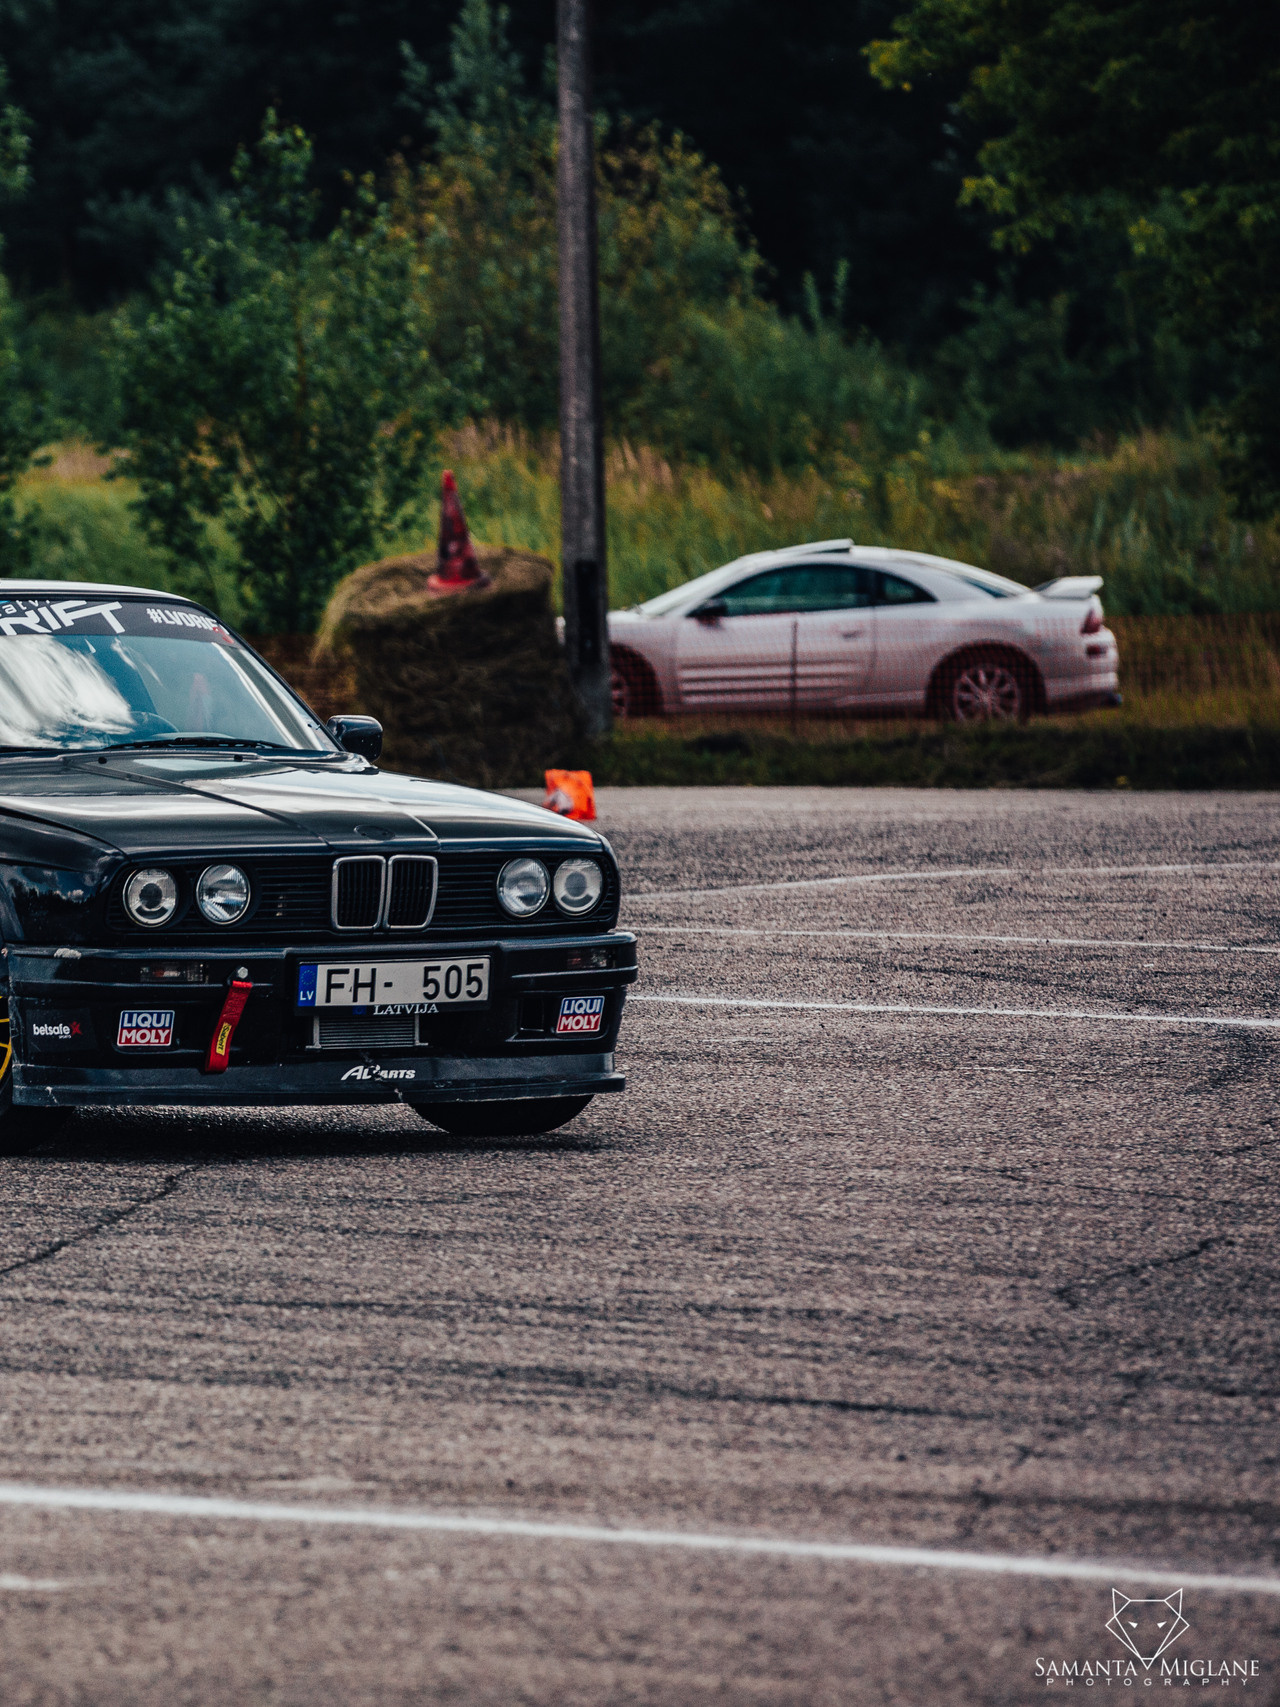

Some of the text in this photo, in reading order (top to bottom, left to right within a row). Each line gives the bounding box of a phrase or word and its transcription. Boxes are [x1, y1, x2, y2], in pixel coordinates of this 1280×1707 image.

[146, 608, 219, 631] #LVDRIF
[422, 963, 484, 1000] 505
[300, 991, 314, 1001] LV
[373, 1003, 439, 1016] LATVIJA
[563, 999, 601, 1014] LIQUI
[123, 1013, 170, 1028] LIQUI
[560, 1014, 600, 1030] MOLY
[32, 1023, 70, 1036] betsafe
[121, 1029, 169, 1044] MOLY
